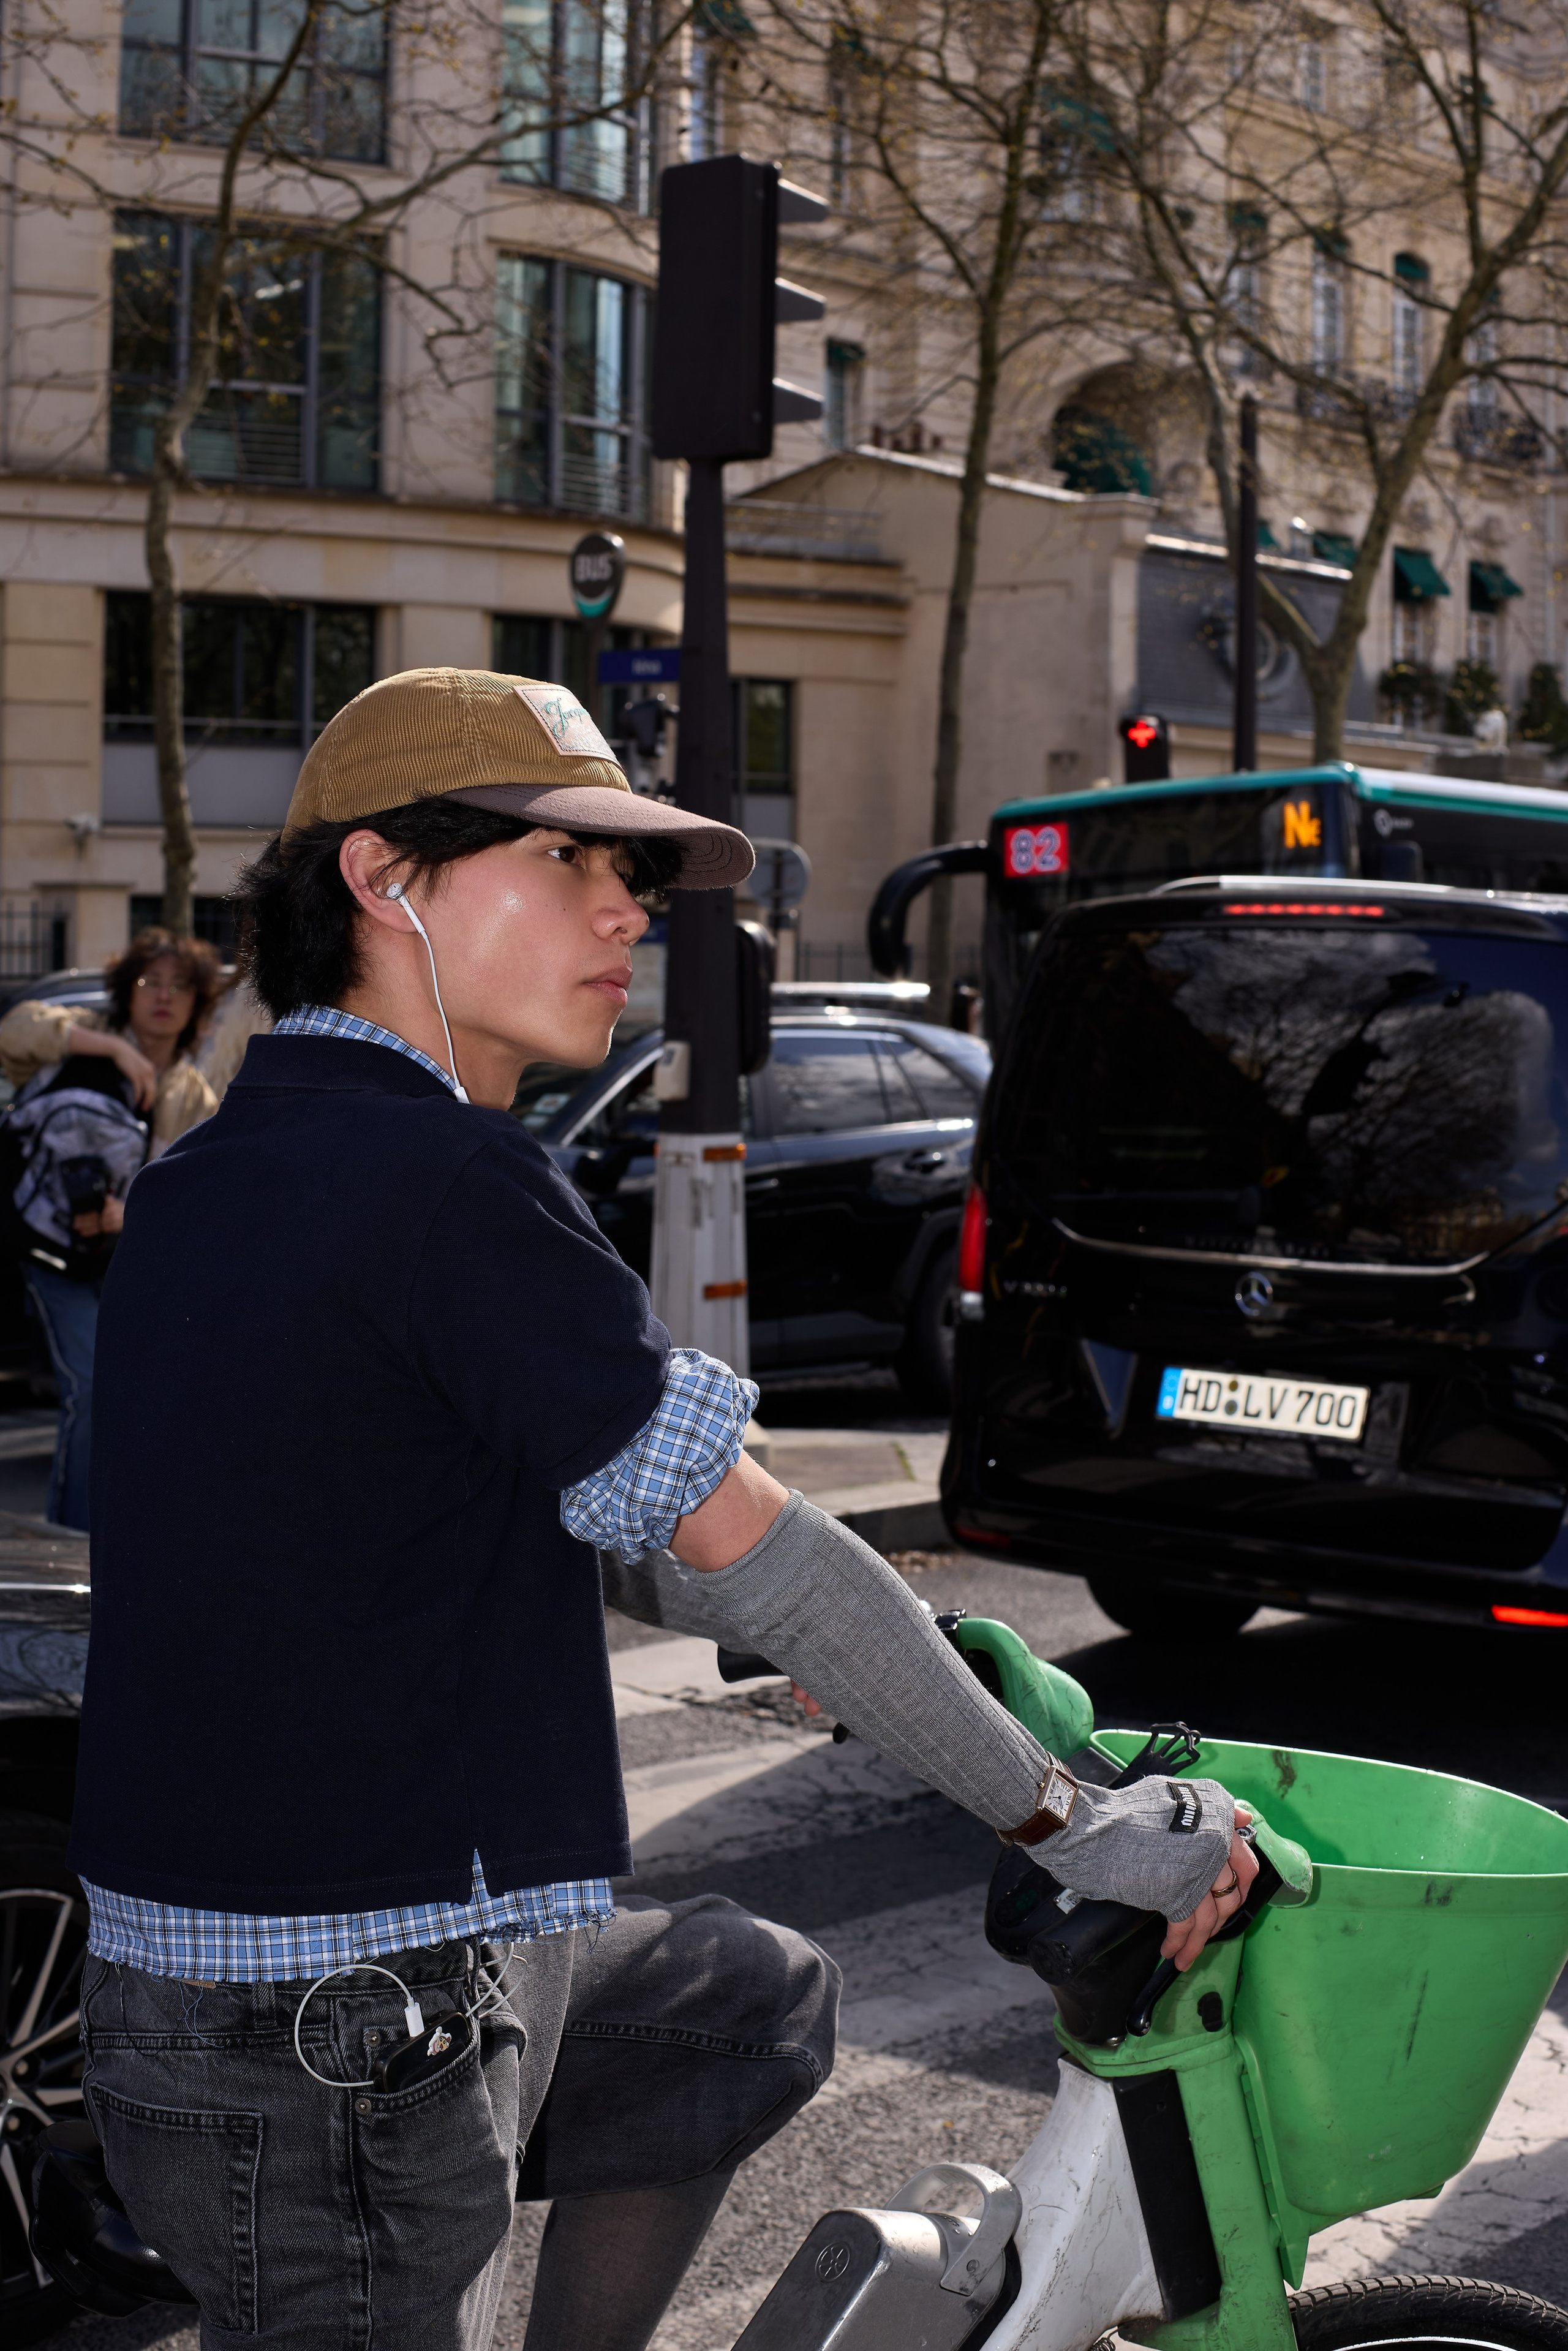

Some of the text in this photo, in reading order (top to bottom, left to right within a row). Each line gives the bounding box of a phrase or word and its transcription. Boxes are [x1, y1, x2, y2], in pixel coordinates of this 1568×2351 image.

[576, 554, 612, 583] BUS
[1010, 827, 1062, 874] 82
[1180, 1377, 1223, 1413] HD
[1243, 1383, 1289, 1419] LV
[1296, 1390, 1357, 1428] 700
